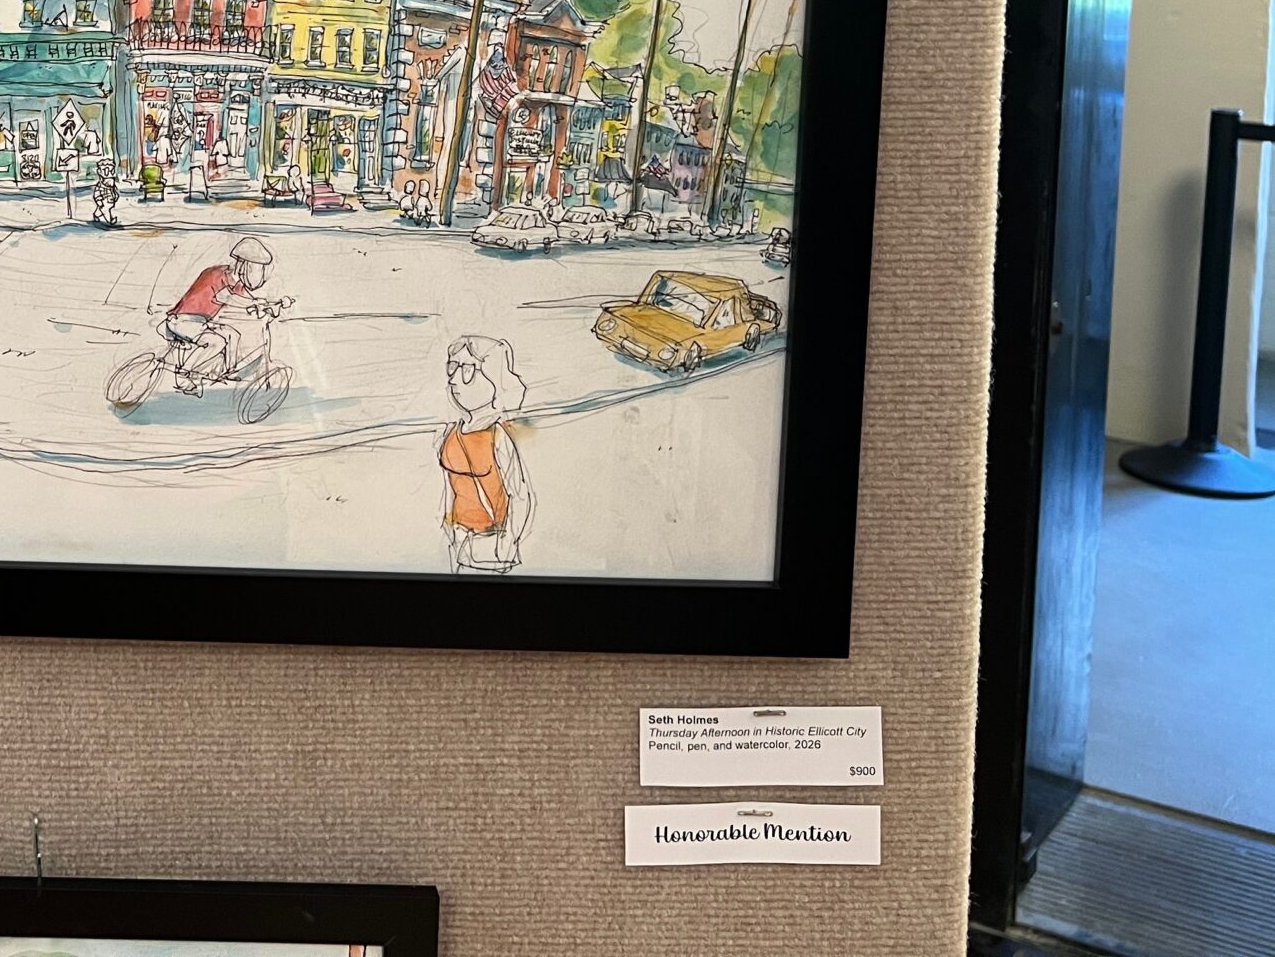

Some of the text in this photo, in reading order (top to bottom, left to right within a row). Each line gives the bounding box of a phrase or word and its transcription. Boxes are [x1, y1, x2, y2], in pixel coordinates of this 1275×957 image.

[648, 715, 720, 725] Seth Holmes
[650, 726, 868, 740] Thursday Afternoon in Historic Ellicott City
[648, 739, 822, 753] Pencil, pen, and watercolor, 2026
[849, 766, 877, 777] $900
[654, 822, 852, 844] Honorable Mention
